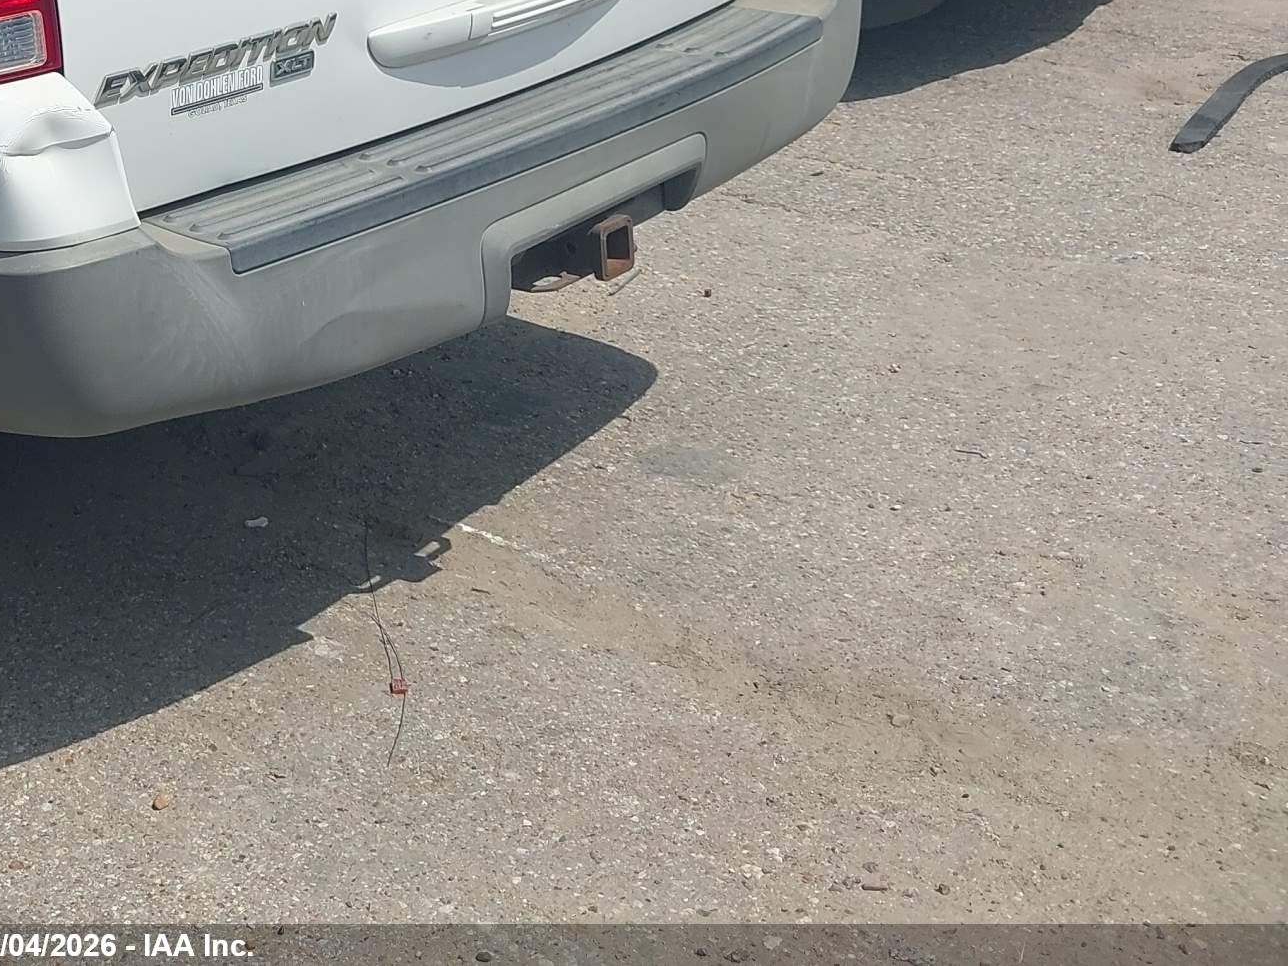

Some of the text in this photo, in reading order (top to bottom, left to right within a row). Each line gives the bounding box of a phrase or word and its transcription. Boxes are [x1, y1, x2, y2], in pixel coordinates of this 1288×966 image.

[93, 12, 339, 109] EXPEDITION
[172, 64, 263, 108] VON DOHLEN FORD
